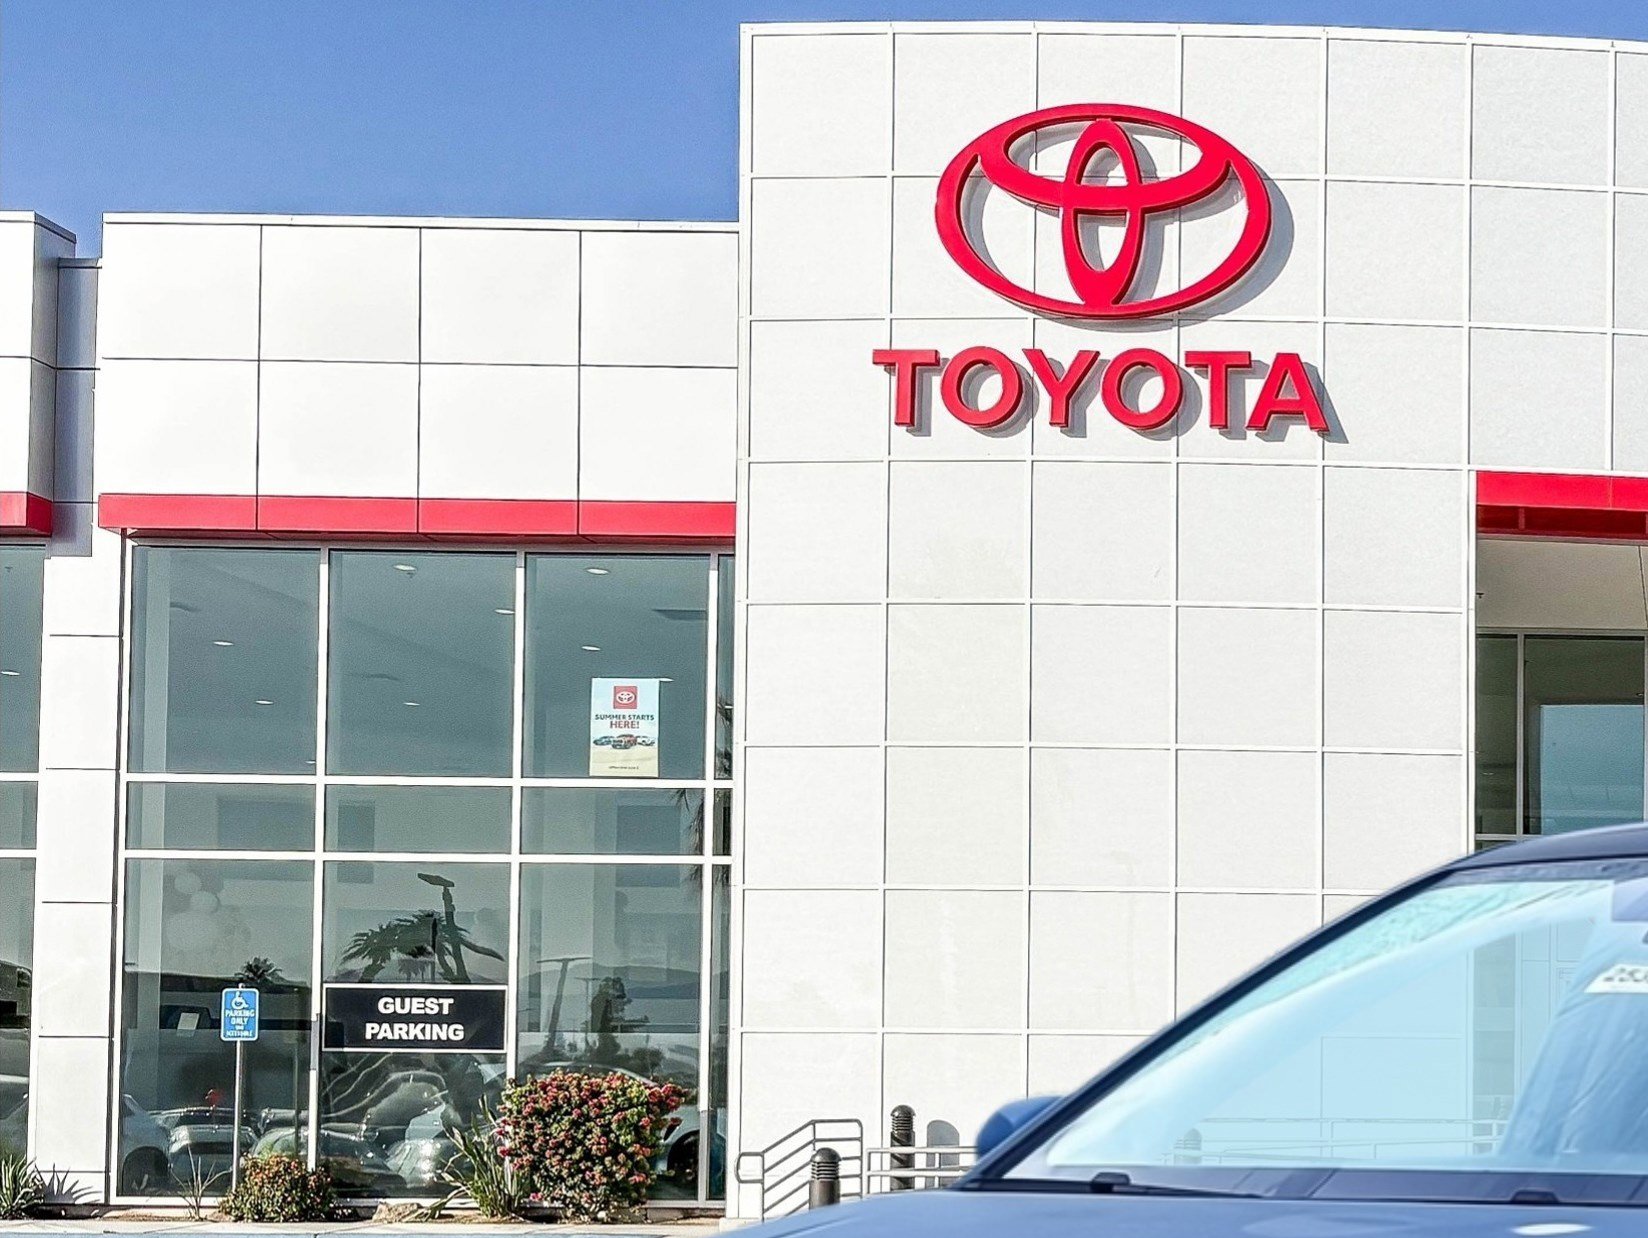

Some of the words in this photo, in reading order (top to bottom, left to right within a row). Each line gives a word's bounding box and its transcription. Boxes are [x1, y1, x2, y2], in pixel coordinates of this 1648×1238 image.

[873, 346, 1330, 433] TOYOTA
[609, 720, 640, 729] HERE!
[377, 996, 455, 1015] GUEST
[365, 1022, 465, 1041] PARKING
